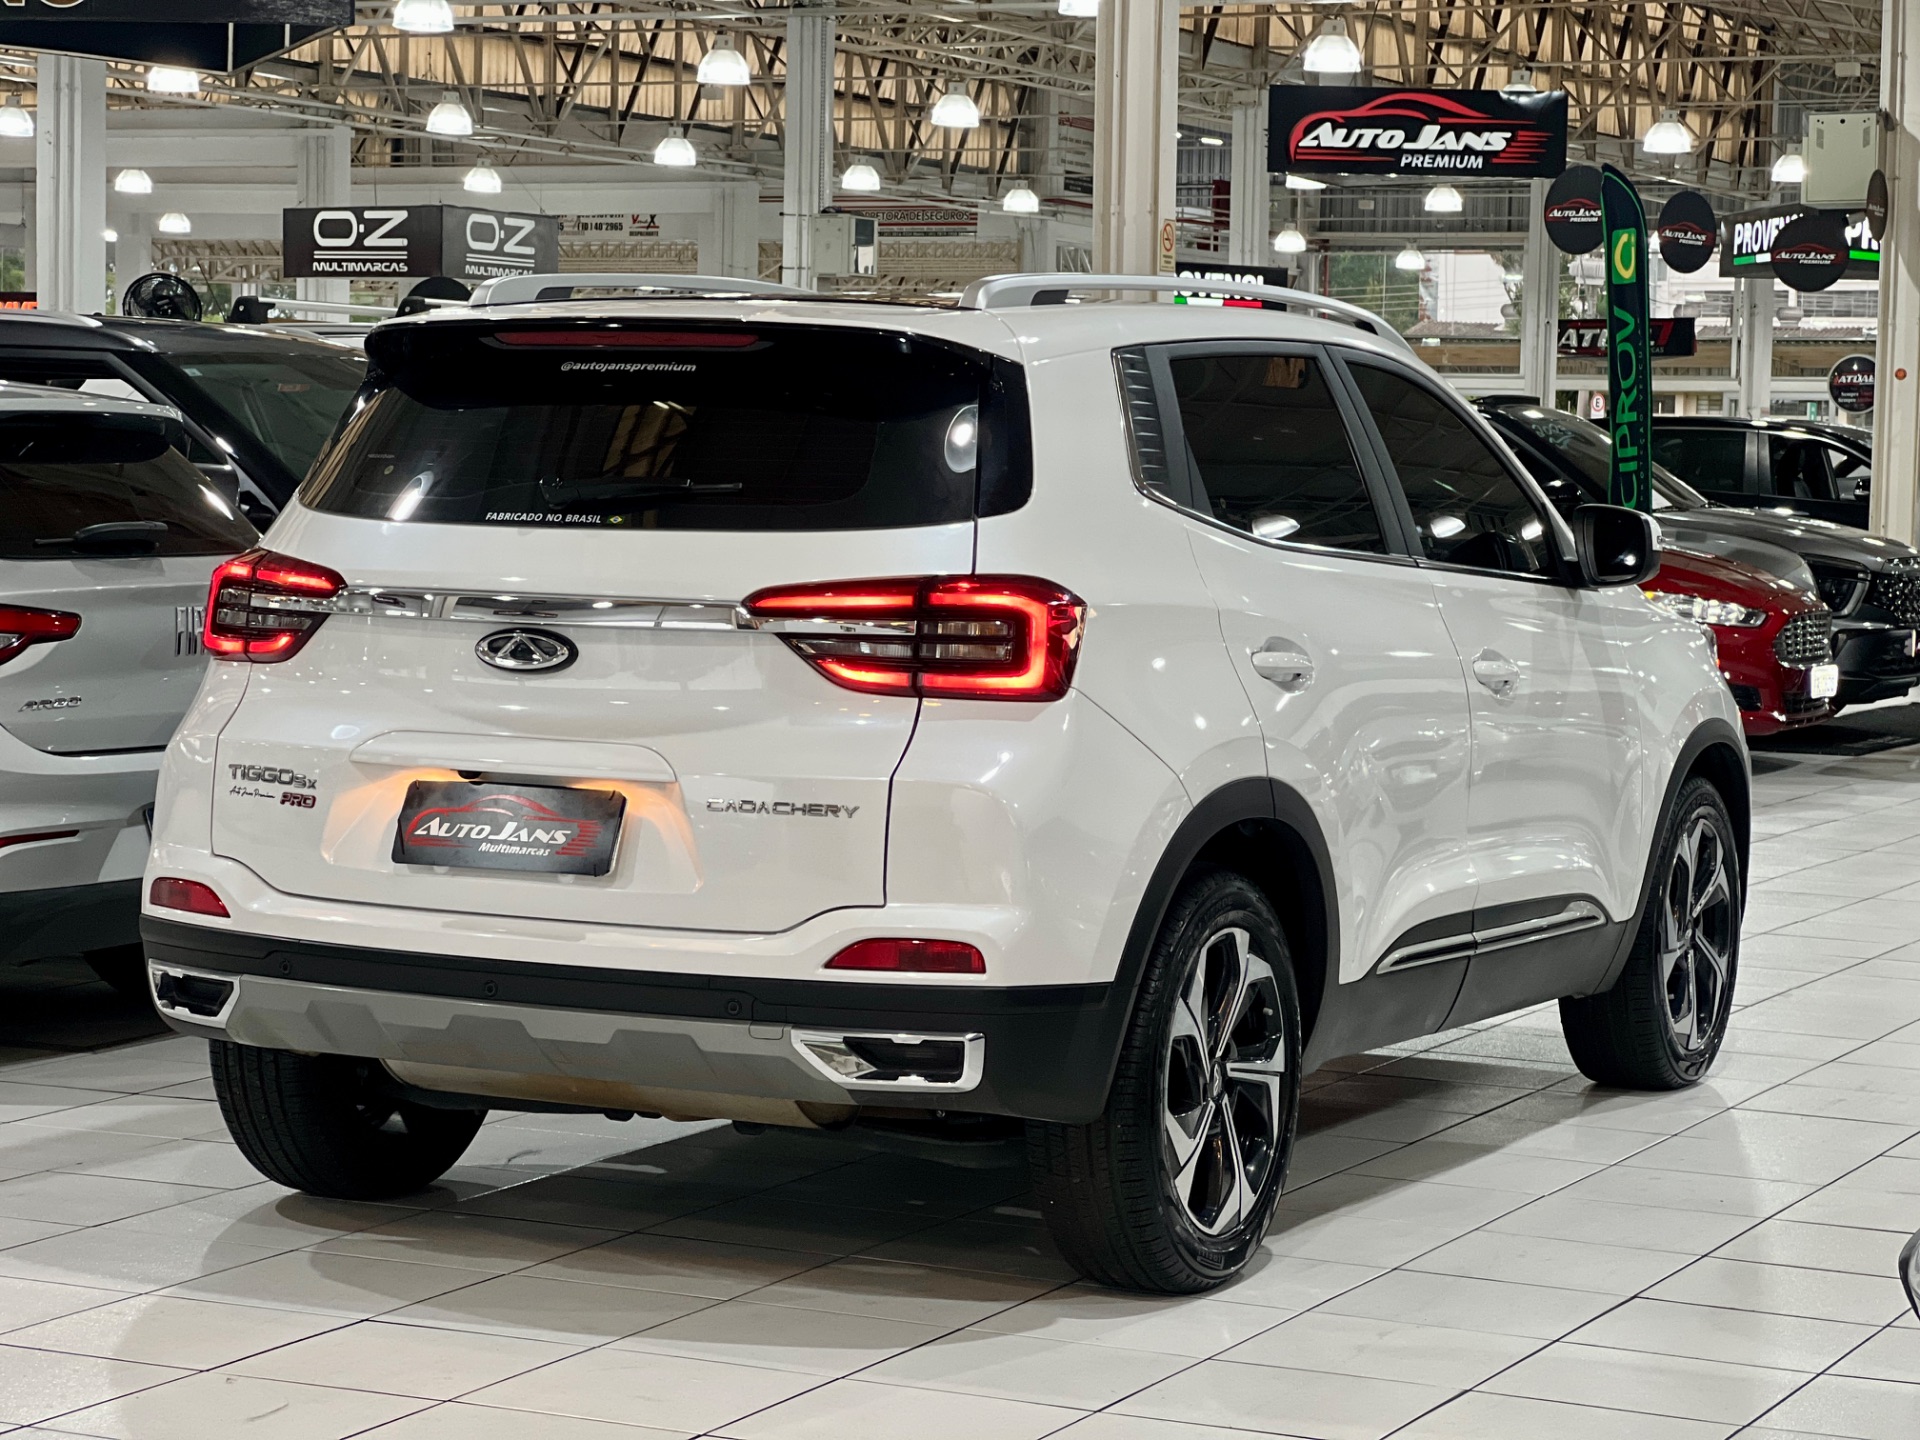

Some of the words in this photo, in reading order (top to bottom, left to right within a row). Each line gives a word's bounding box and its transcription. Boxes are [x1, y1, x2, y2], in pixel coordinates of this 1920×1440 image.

[1400, 153, 1483, 169] PREMIUM
[909, 210, 923, 220] DE
[924, 210, 969, 220] SEGUROS
[1679, 238, 1703, 246] PREMIUM
[312, 262, 408, 272] MULTIMARCAS
[561, 361, 697, 373] @autojanspremium
[1595, 397, 1602, 408] E
[485, 512, 543, 522] FABRICADO
[545, 513, 562, 522] NO
[565, 514, 602, 524] BRASIL
[280, 791, 318, 809] PRO
[478, 842, 550, 857] Multimarcas
